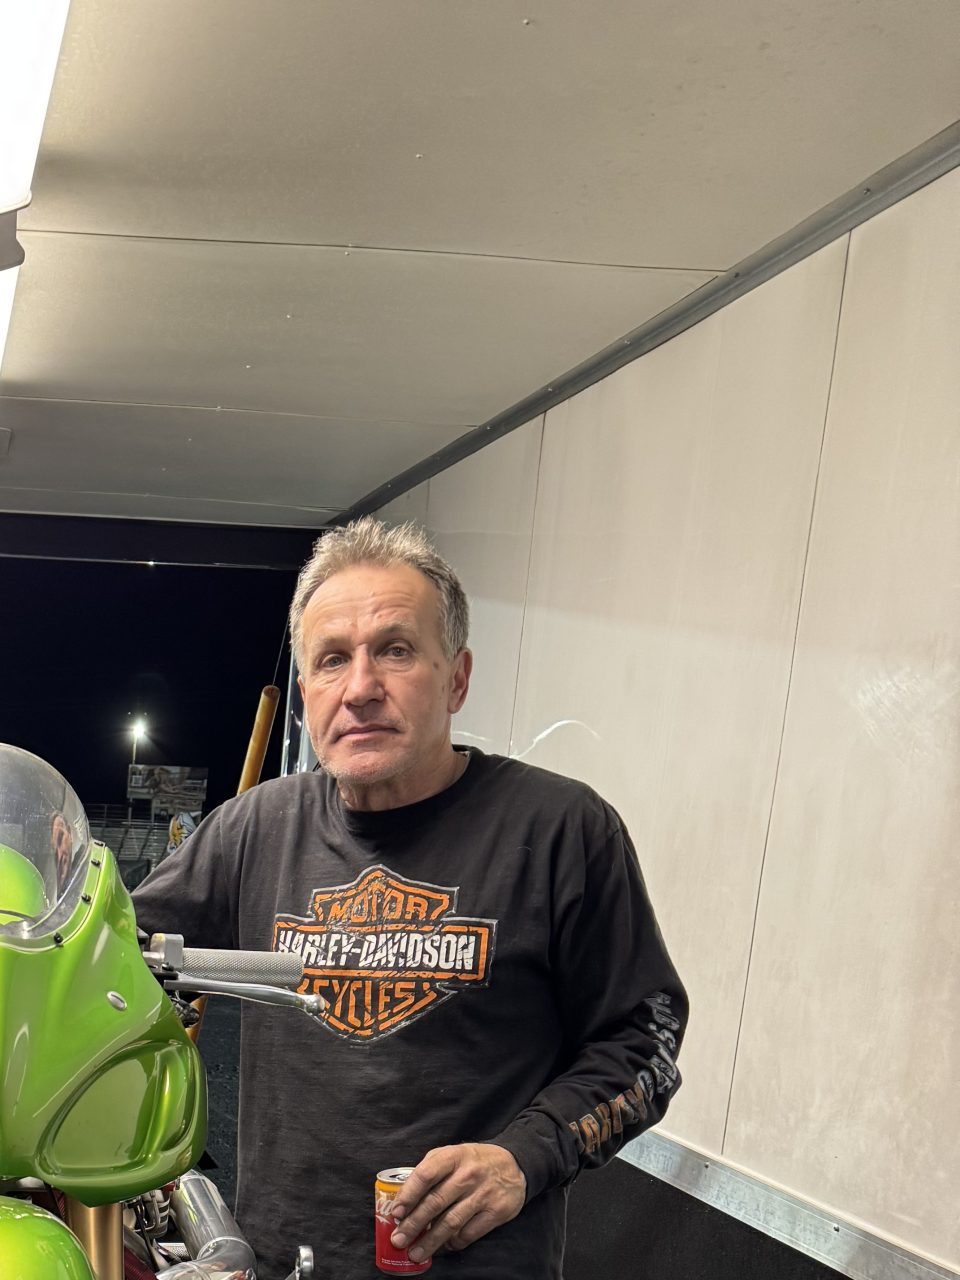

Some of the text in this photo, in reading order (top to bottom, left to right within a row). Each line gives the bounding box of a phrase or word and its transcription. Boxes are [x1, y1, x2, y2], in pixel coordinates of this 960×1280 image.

[326, 887, 429, 924] MOTOR
[277, 929, 476, 970] HARLEY-DAVIDSON
[310, 978, 417, 1028] CYCLES
